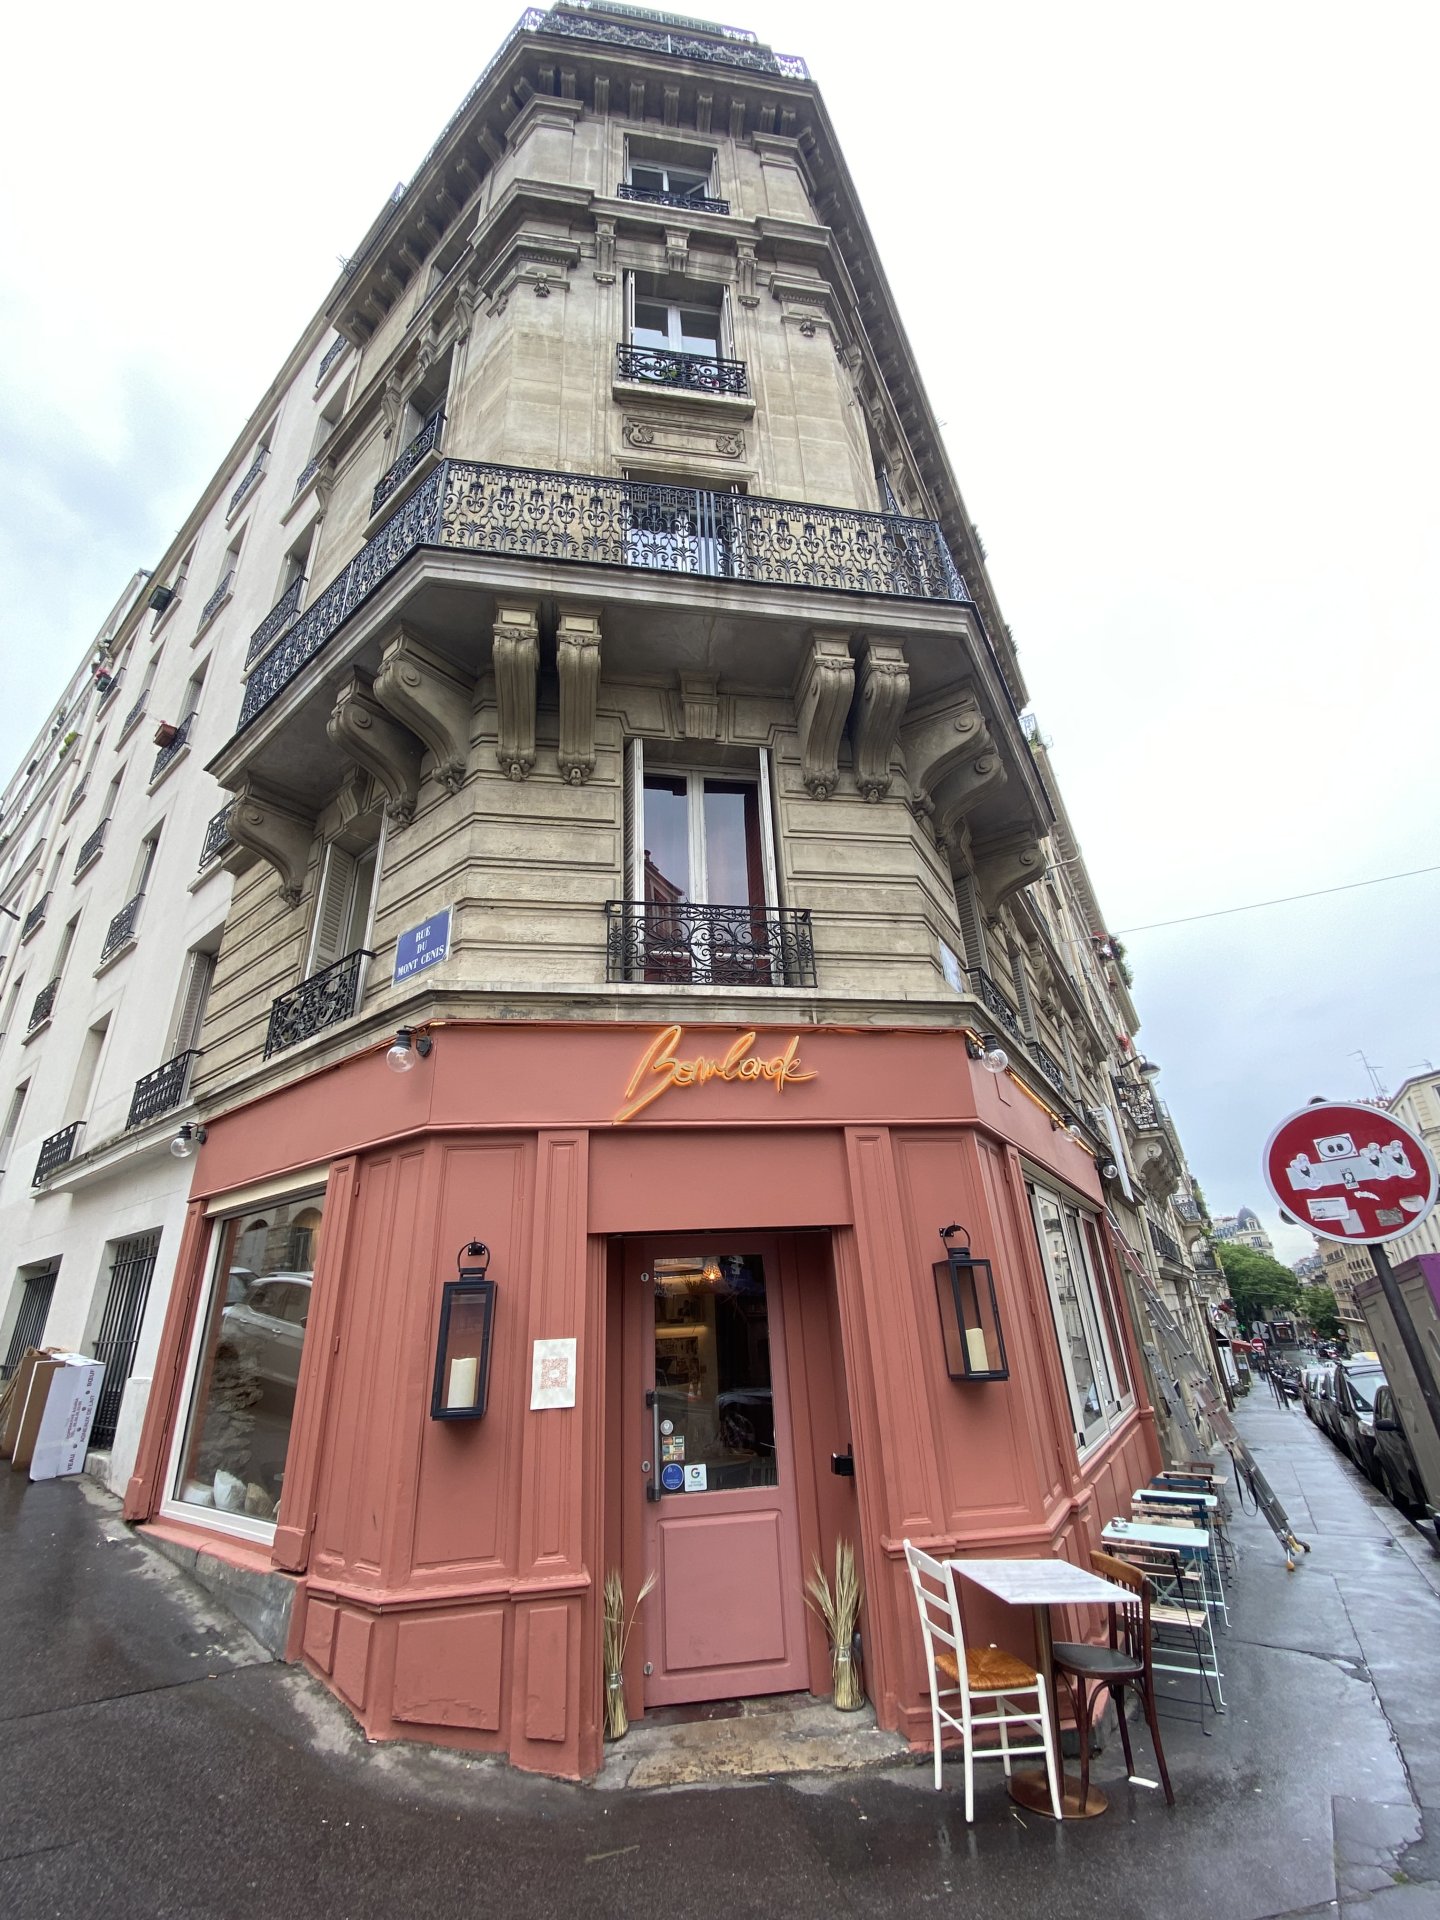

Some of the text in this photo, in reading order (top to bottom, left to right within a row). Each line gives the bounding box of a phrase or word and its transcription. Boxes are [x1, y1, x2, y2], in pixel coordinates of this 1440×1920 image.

[416, 926, 431, 942] RUE
[416, 940, 428, 955] DU
[397, 944, 445, 977] MONT CENIS
[612, 1025, 818, 1125] Bombarde
[67, 1454, 75, 1471] VEAU
[691, 1467, 701, 1479] G
